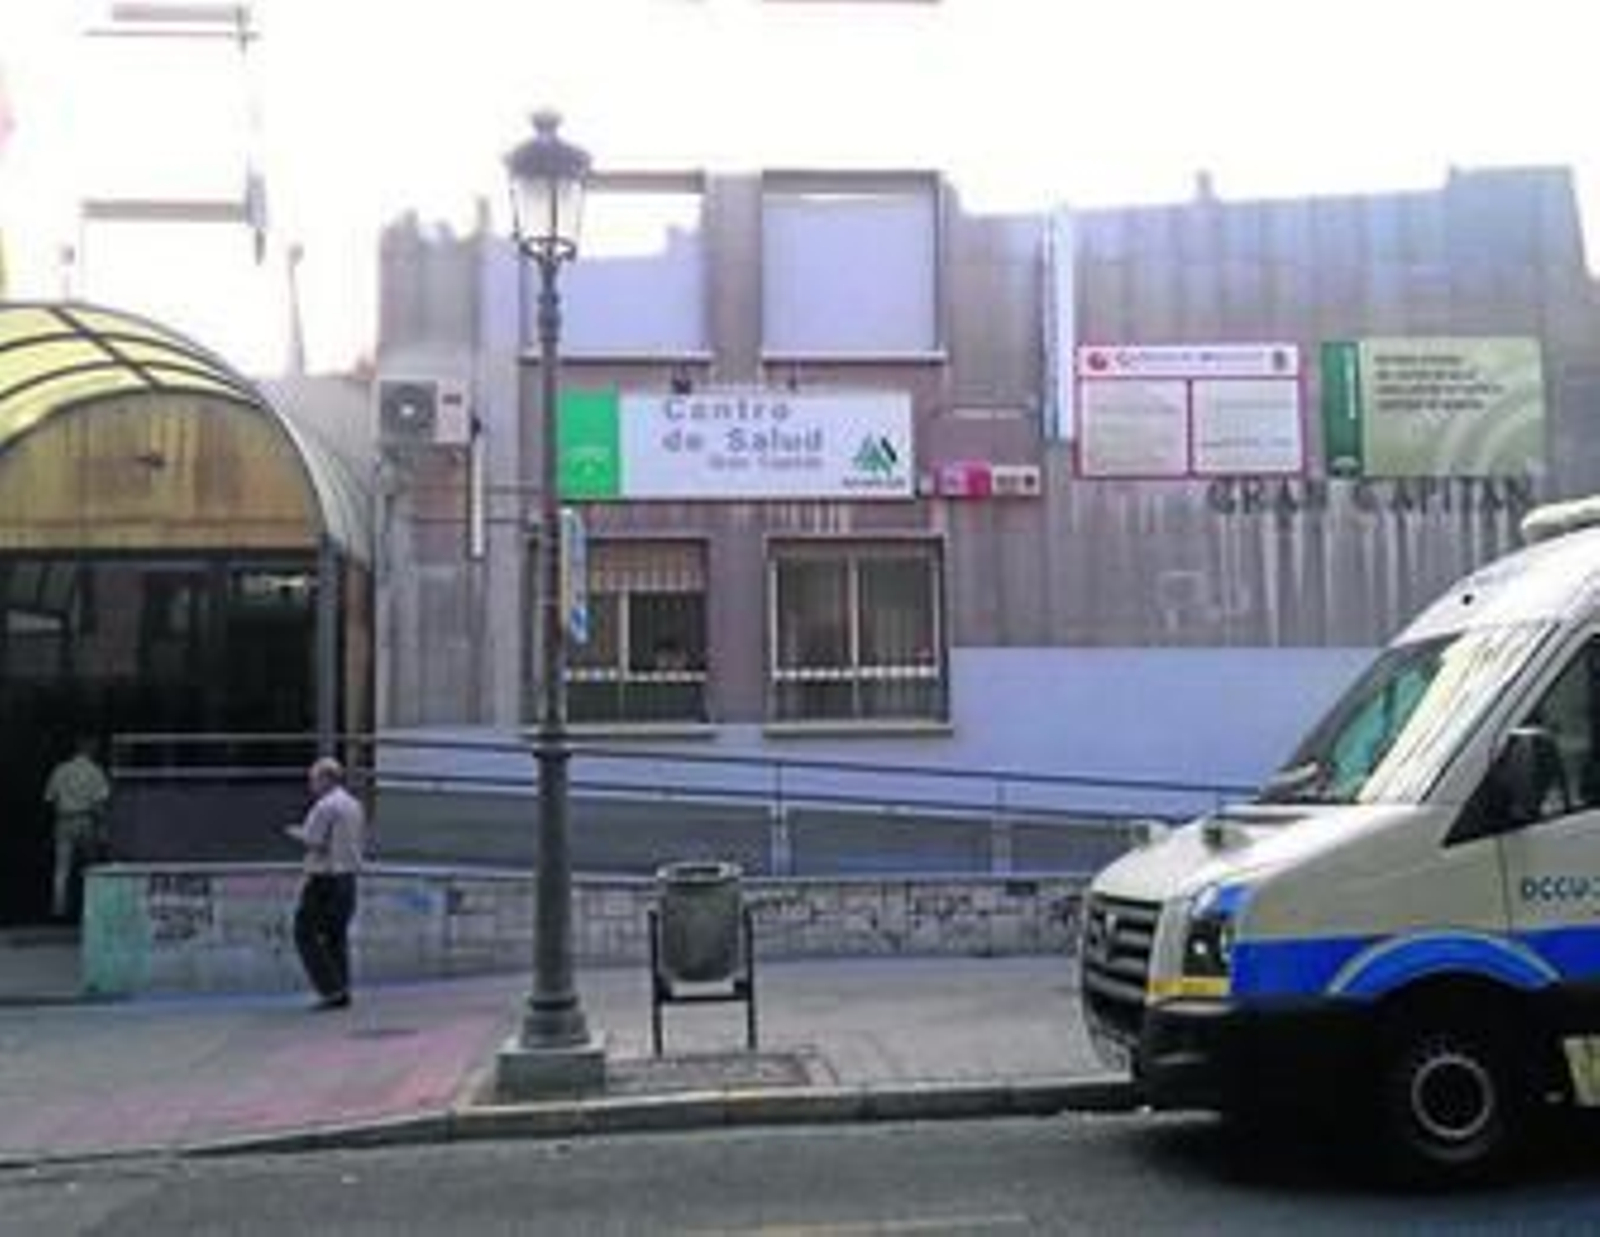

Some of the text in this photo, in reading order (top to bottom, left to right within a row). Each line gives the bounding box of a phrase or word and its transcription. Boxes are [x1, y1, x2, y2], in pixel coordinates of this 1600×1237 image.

[665, 397, 791, 421] Centro
[661, 426, 823, 452] de Salud
